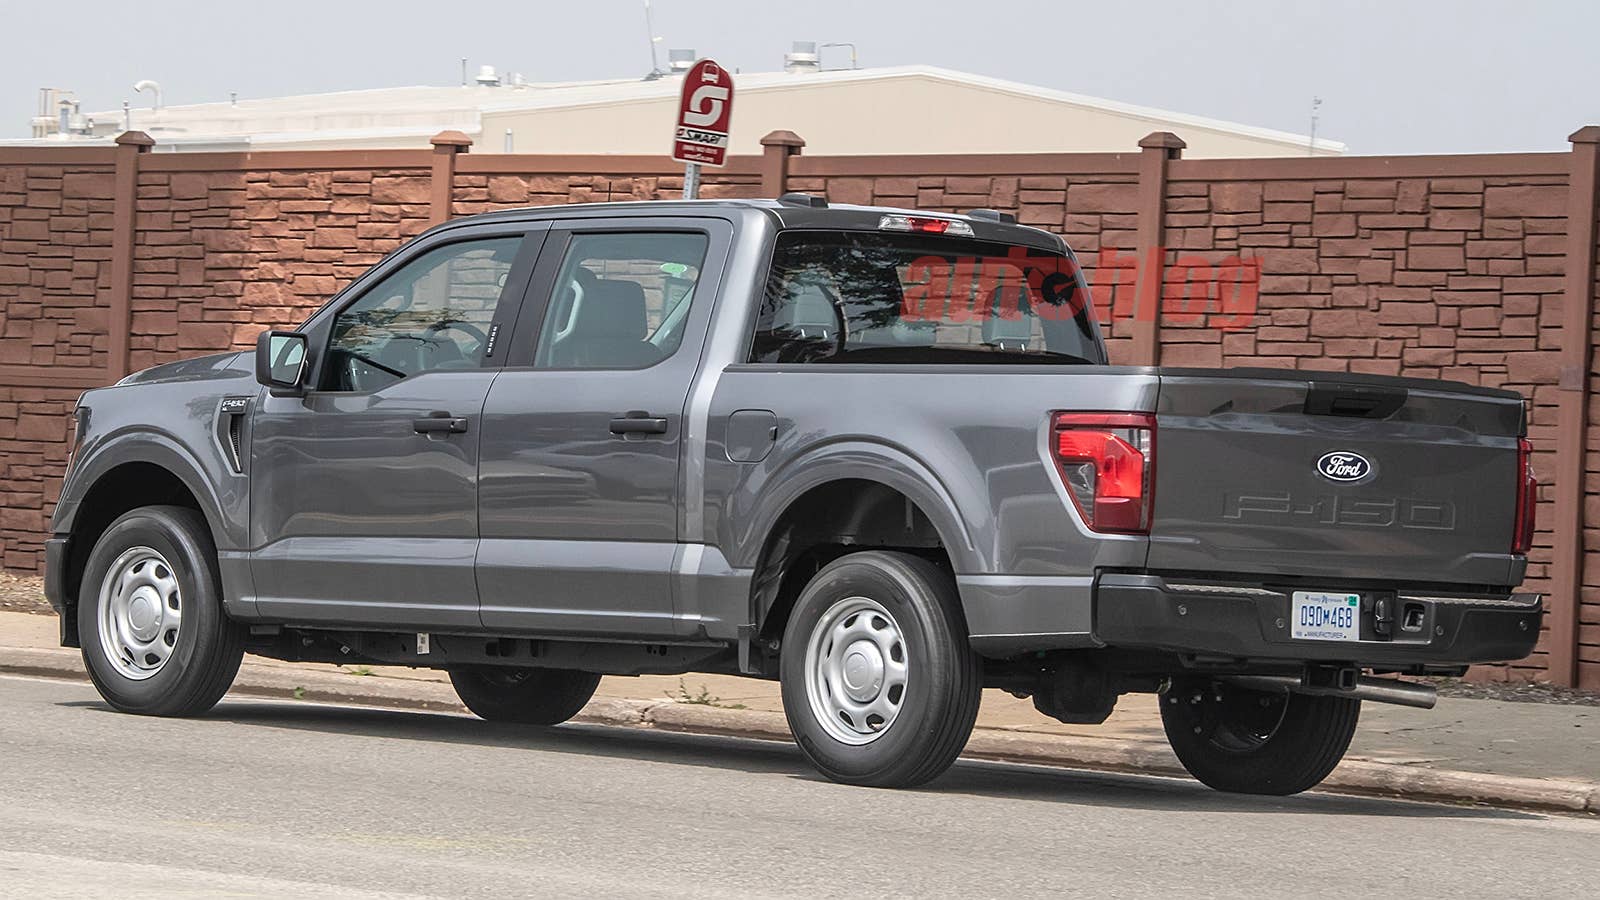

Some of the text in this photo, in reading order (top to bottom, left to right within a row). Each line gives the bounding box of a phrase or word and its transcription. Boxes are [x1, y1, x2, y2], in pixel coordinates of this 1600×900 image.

[1326, 454, 1361, 477] Ford
[1223, 492, 1456, 531] F-150
[1301, 605, 1353, 628] 090M468
